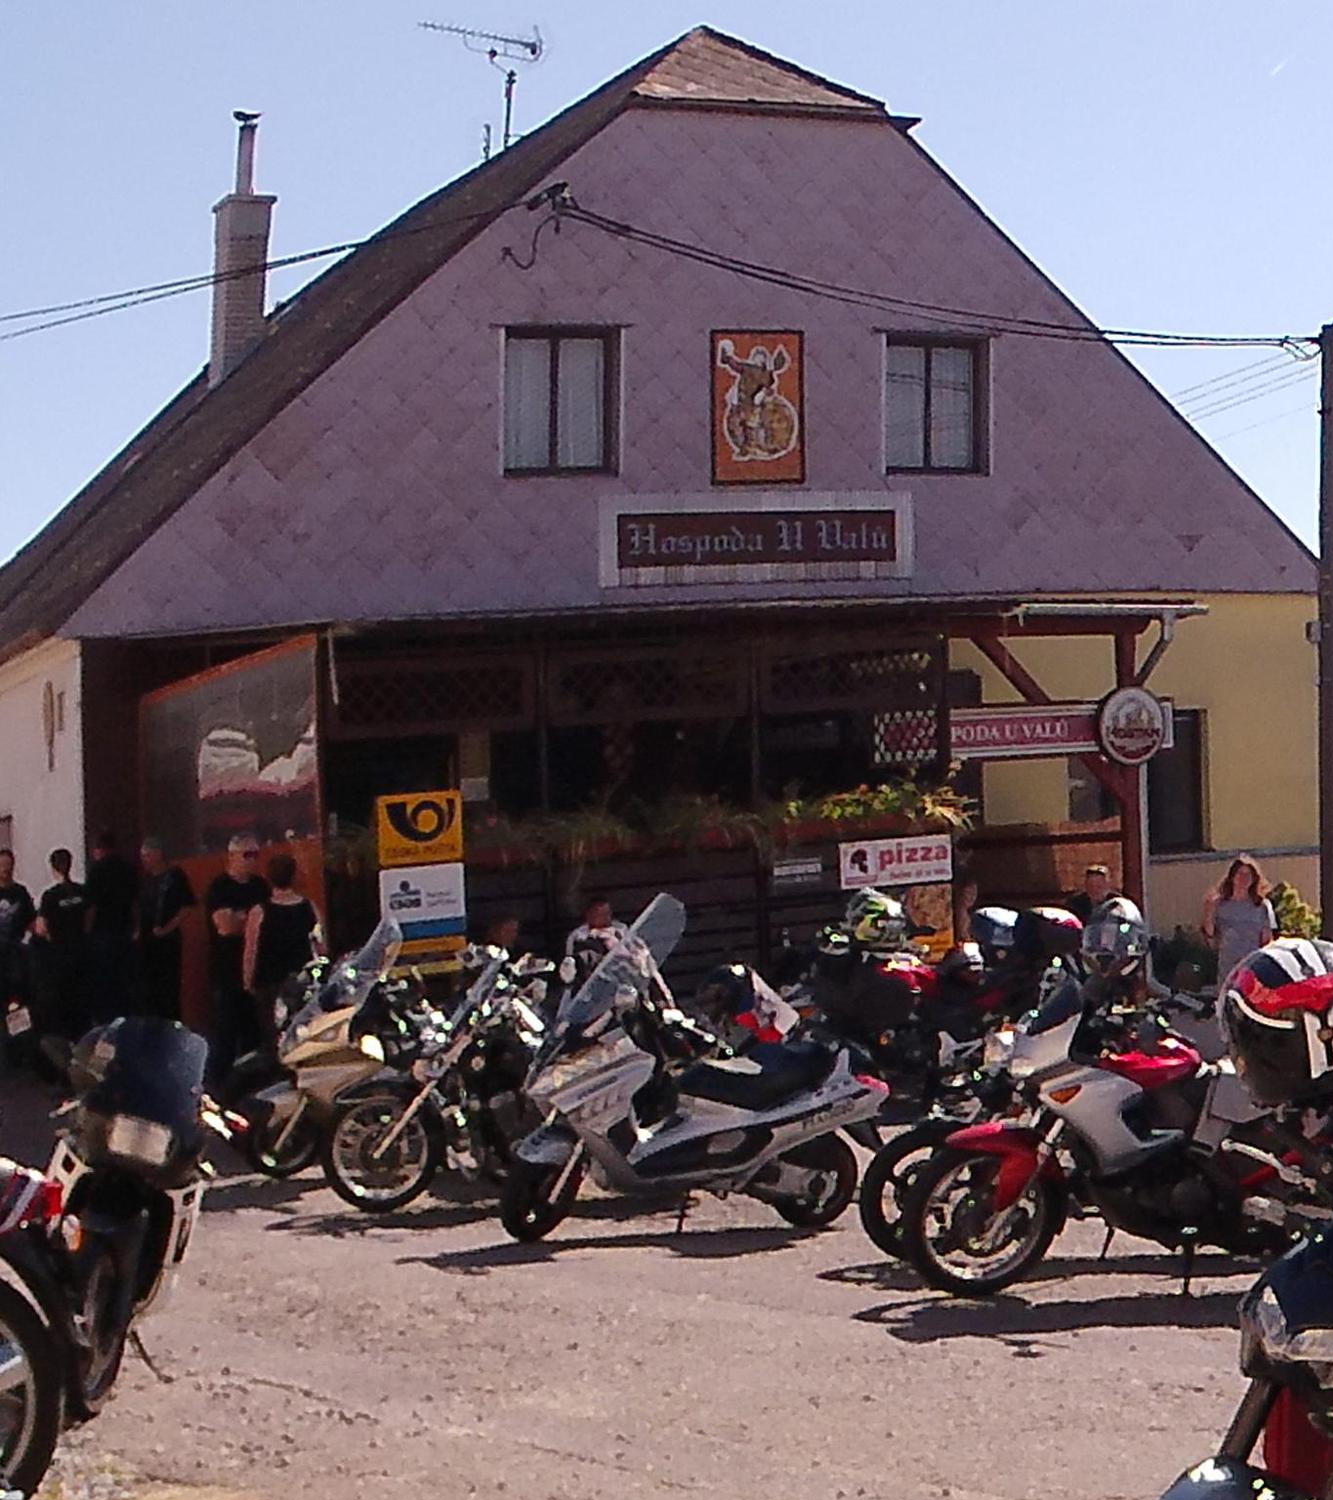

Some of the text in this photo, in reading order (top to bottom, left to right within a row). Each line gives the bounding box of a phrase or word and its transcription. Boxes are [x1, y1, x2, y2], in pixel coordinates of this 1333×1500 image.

[628, 523, 764, 560] Hospoda
[776, 518, 803, 551] U
[1005, 724, 1018, 738] U
[879, 842, 948, 871] pizza
